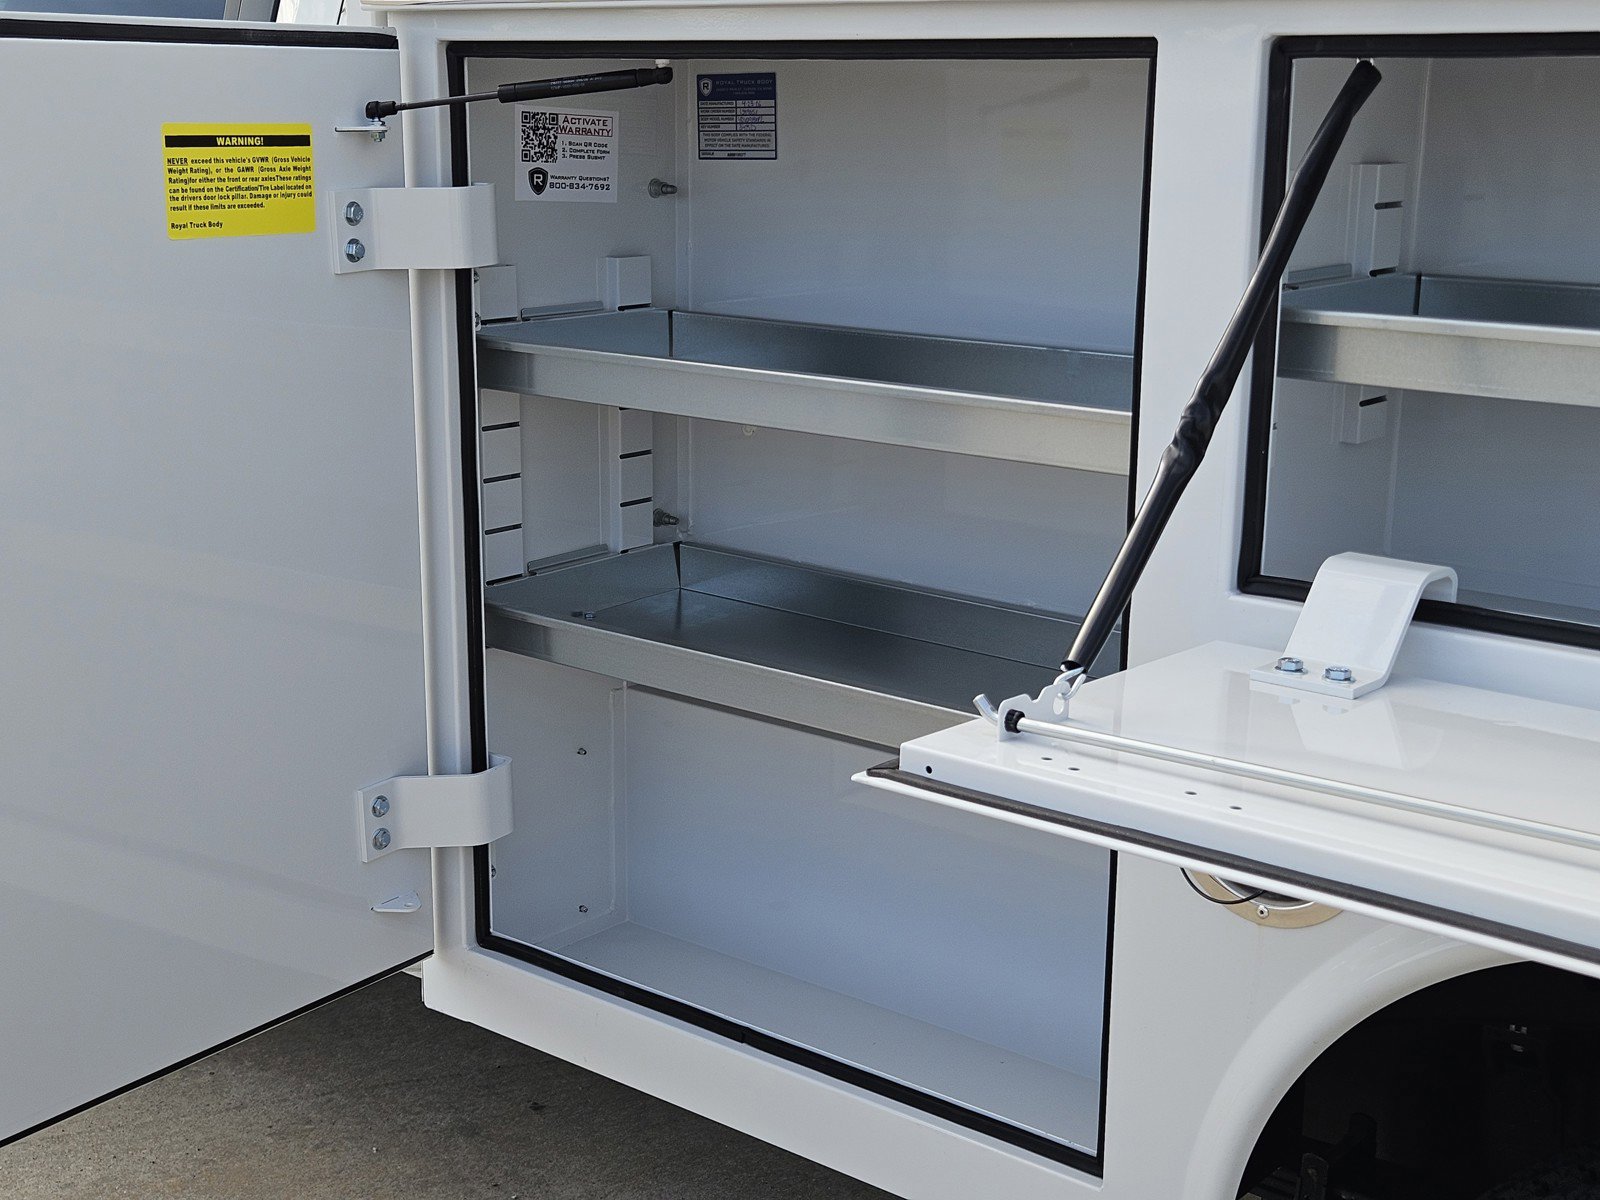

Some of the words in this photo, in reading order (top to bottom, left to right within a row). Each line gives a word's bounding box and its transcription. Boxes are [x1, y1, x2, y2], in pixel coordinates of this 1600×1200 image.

[562, 116, 608, 127] ACTIVATE
[559, 125, 612, 136] WARRANTY
[216, 136, 264, 146] WARNING!
[258, 166, 276, 174] (Gross
[549, 182, 610, 190] 800-834-7692
[171, 222, 188, 230] Royal
